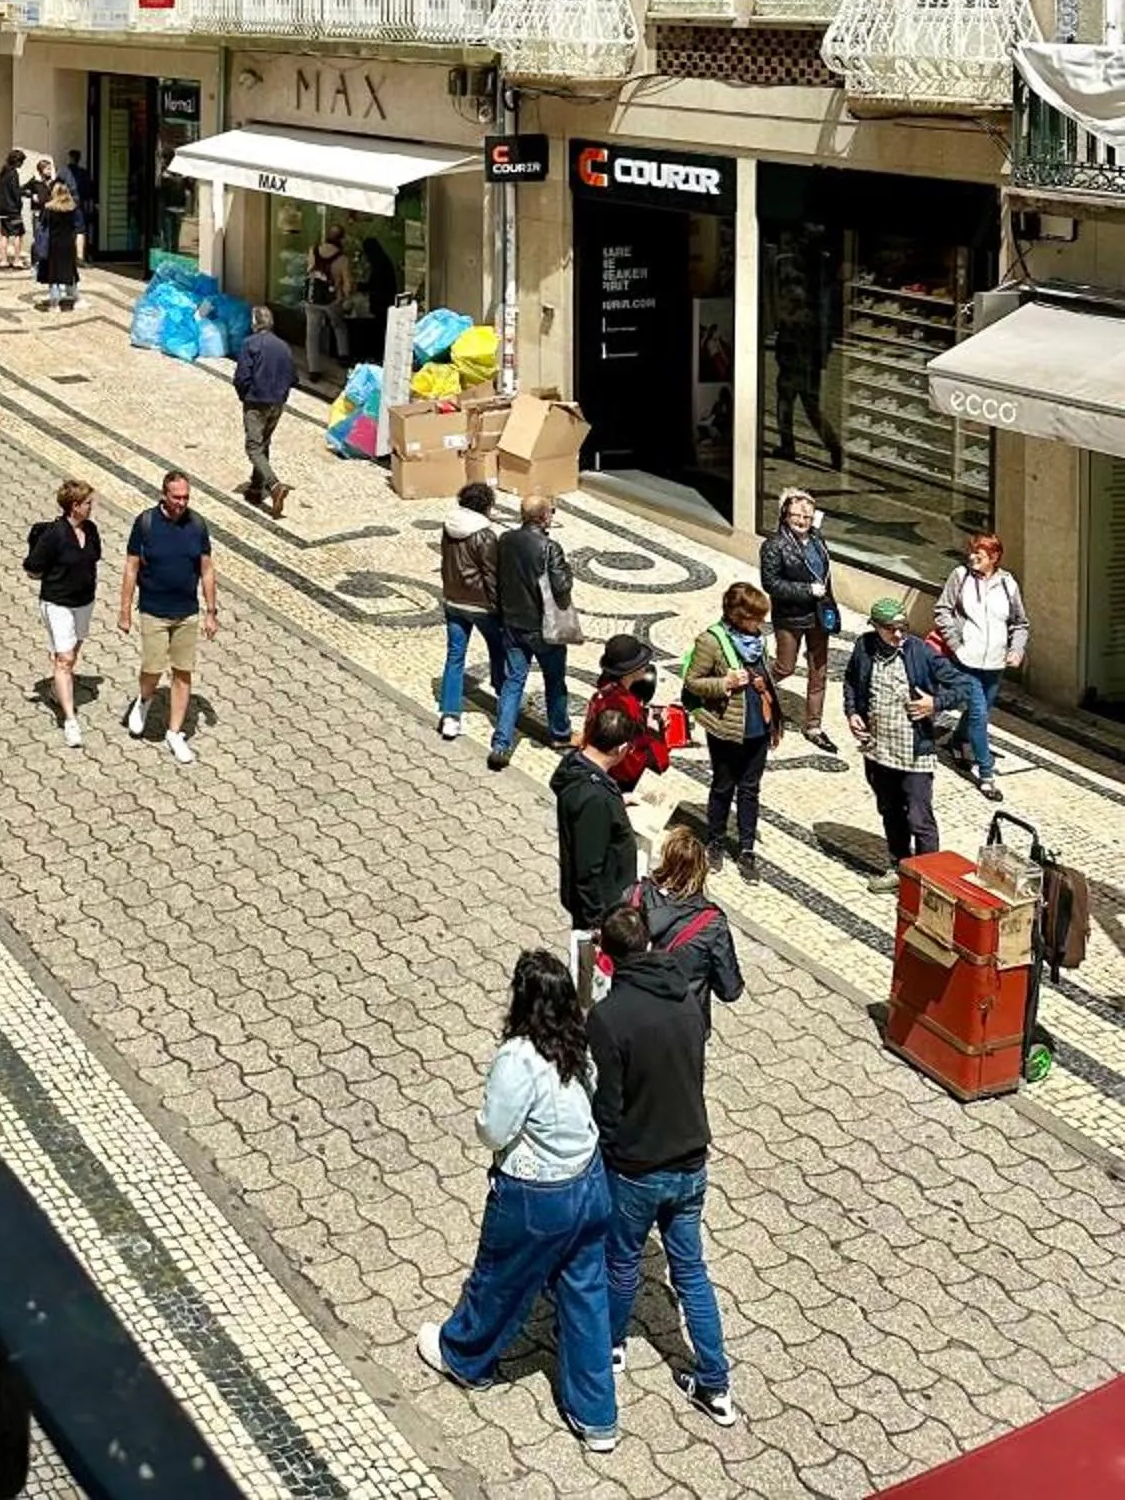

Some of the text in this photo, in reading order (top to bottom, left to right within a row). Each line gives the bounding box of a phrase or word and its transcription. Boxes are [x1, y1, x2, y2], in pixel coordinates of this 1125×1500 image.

[296, 68, 387, 121] MAX
[258, 173, 289, 193] MAX
[493, 161, 542, 174] COURIR
[613, 157, 722, 195] COURIR
[950, 390, 1017, 423] ecco
